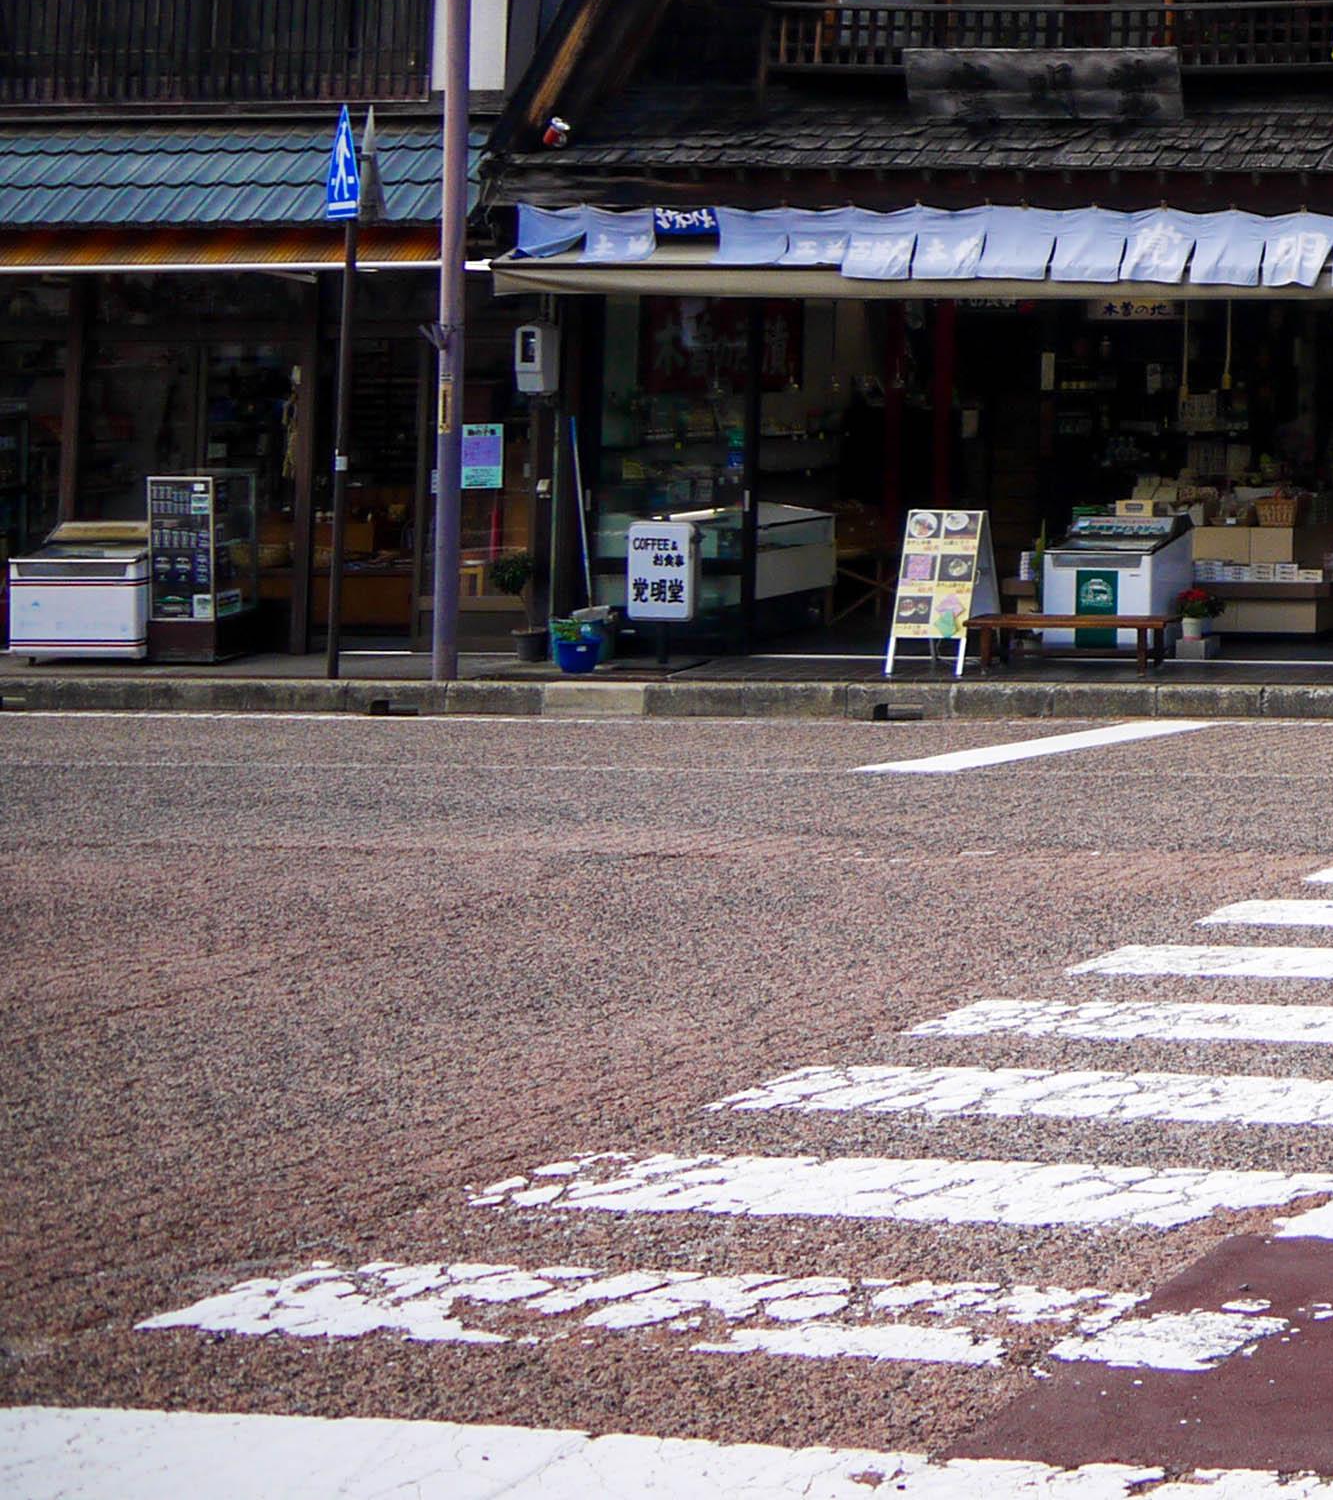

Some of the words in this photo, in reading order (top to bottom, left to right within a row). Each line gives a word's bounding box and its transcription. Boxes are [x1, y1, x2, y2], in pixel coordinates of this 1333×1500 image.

[632, 537, 670, 551] COFFEE
[653, 553, 685, 567] お食事
[632, 576, 685, 604] 覚明堂
